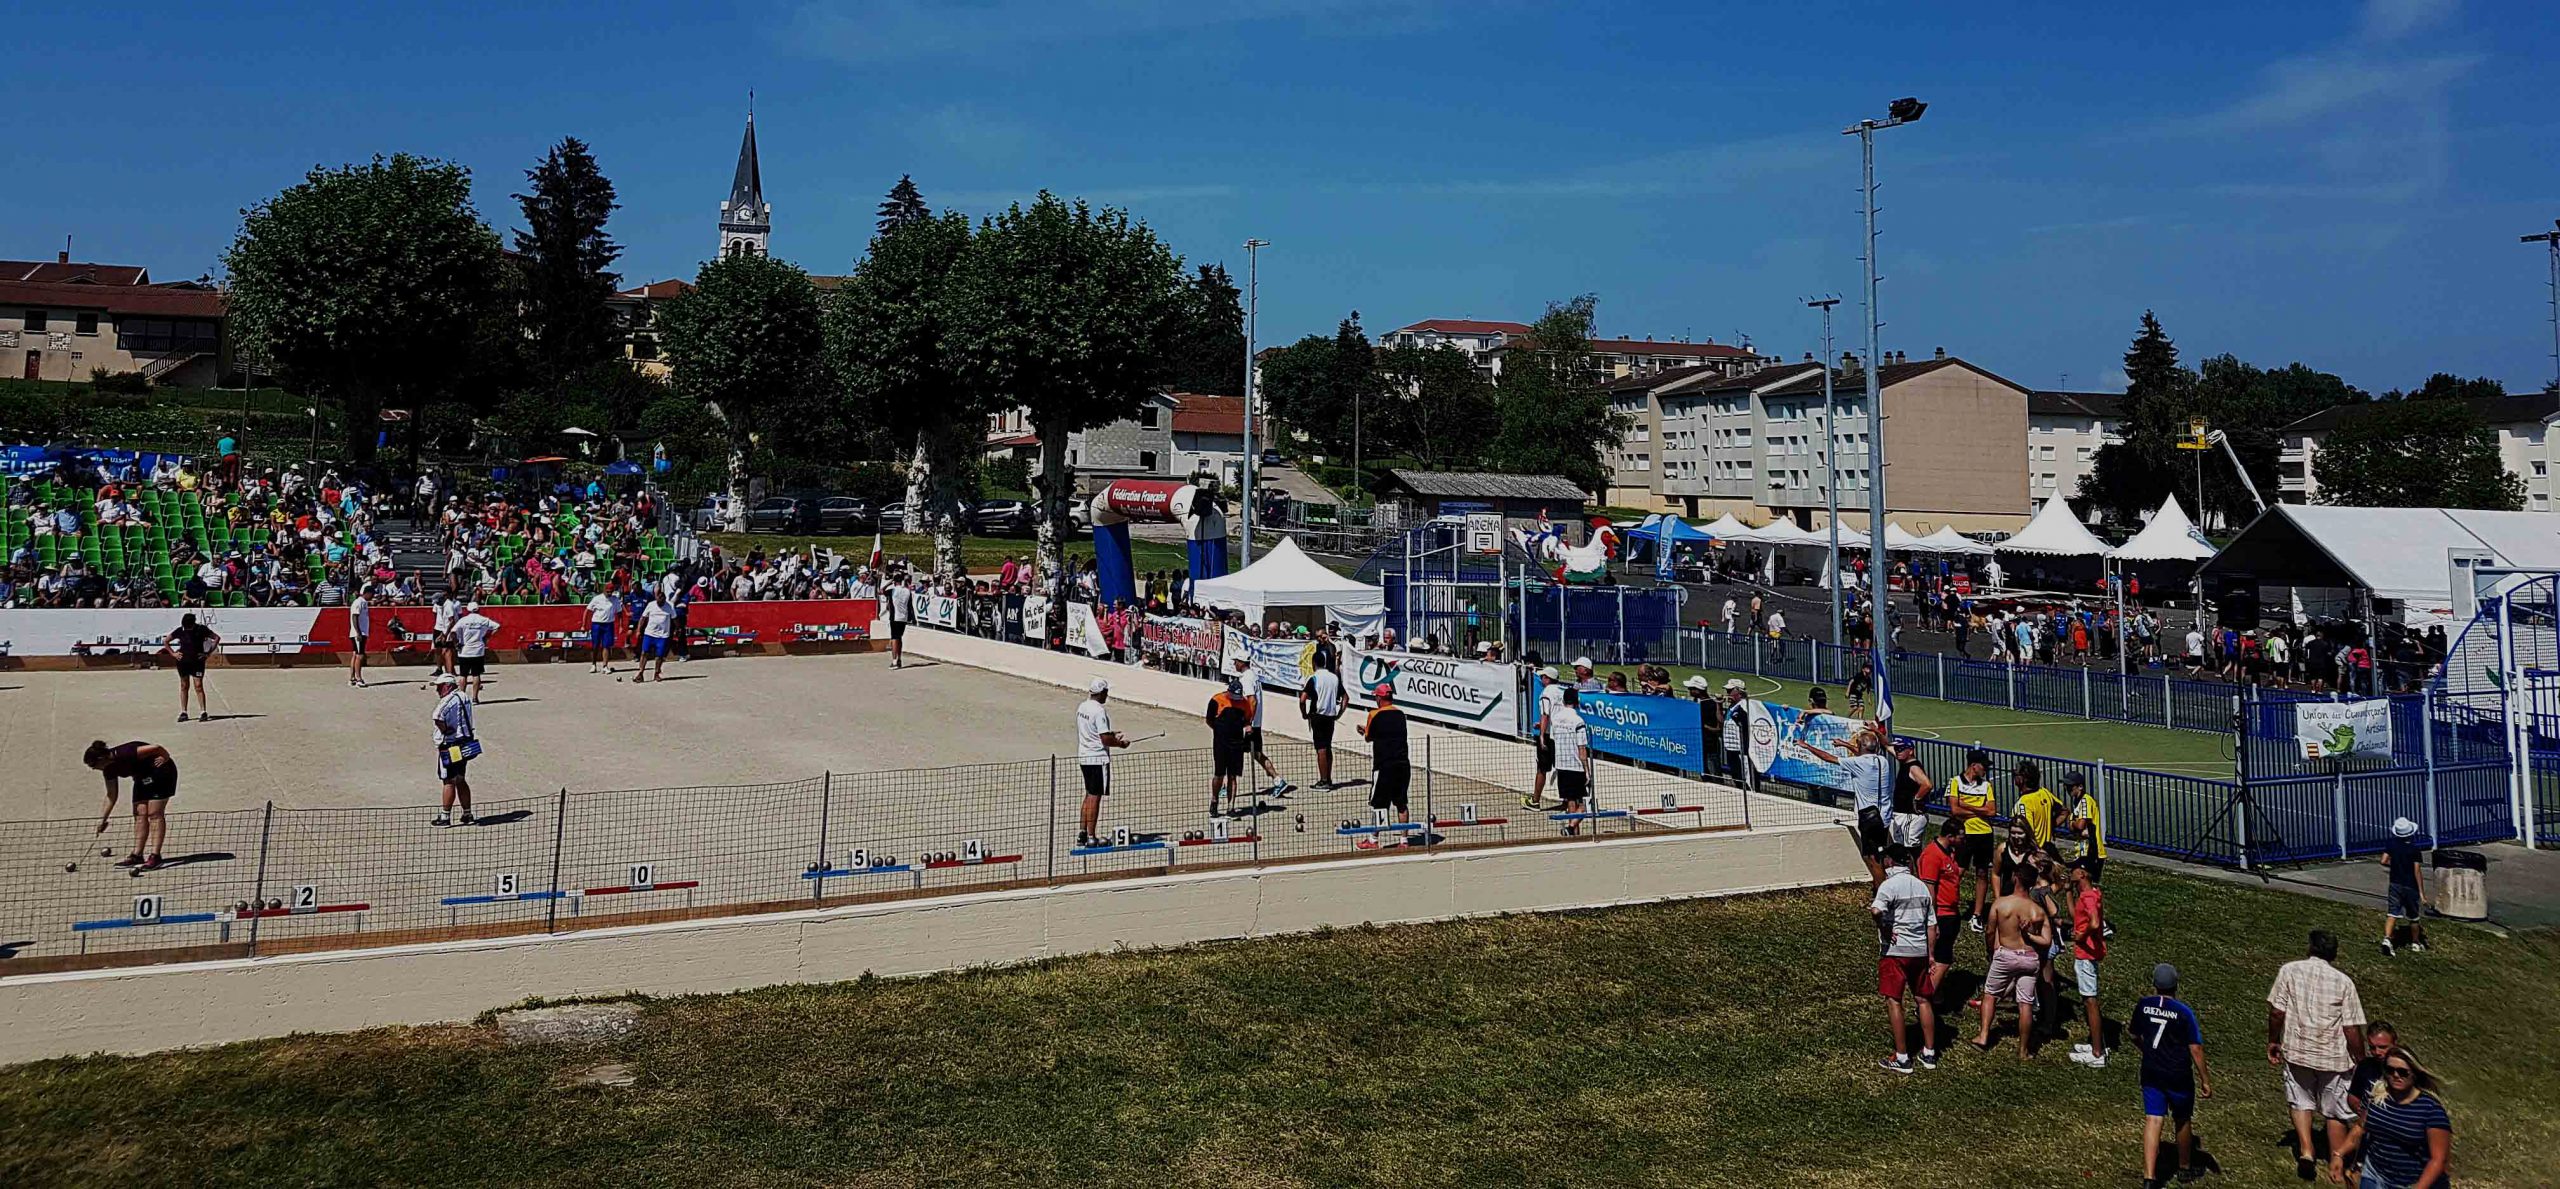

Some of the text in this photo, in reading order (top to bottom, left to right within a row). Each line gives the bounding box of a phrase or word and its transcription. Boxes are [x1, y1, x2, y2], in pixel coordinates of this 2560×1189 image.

[1112, 488, 1168, 506] Fédération Française
[1403, 658, 1459, 679] CRÉDIT
[1407, 677, 1481, 704] AGRICOLE
[1579, 700, 1649, 727] La Région
[2302, 708, 2329, 720] Union
[1587, 724, 1687, 755] vergne-Rhône-Alpes
[1663, 793, 1675, 807] 10
[1466, 806, 1472, 820] 1
[1217, 821, 1223, 837] 1
[854, 849, 864, 866] 5
[968, 841, 977, 857] 4
[501, 875, 513, 893] 5
[637, 866, 648, 884] 0
[300, 887, 313, 906] 2
[139, 898, 153, 917] 0
[2150, 1017, 2168, 1049] 7
